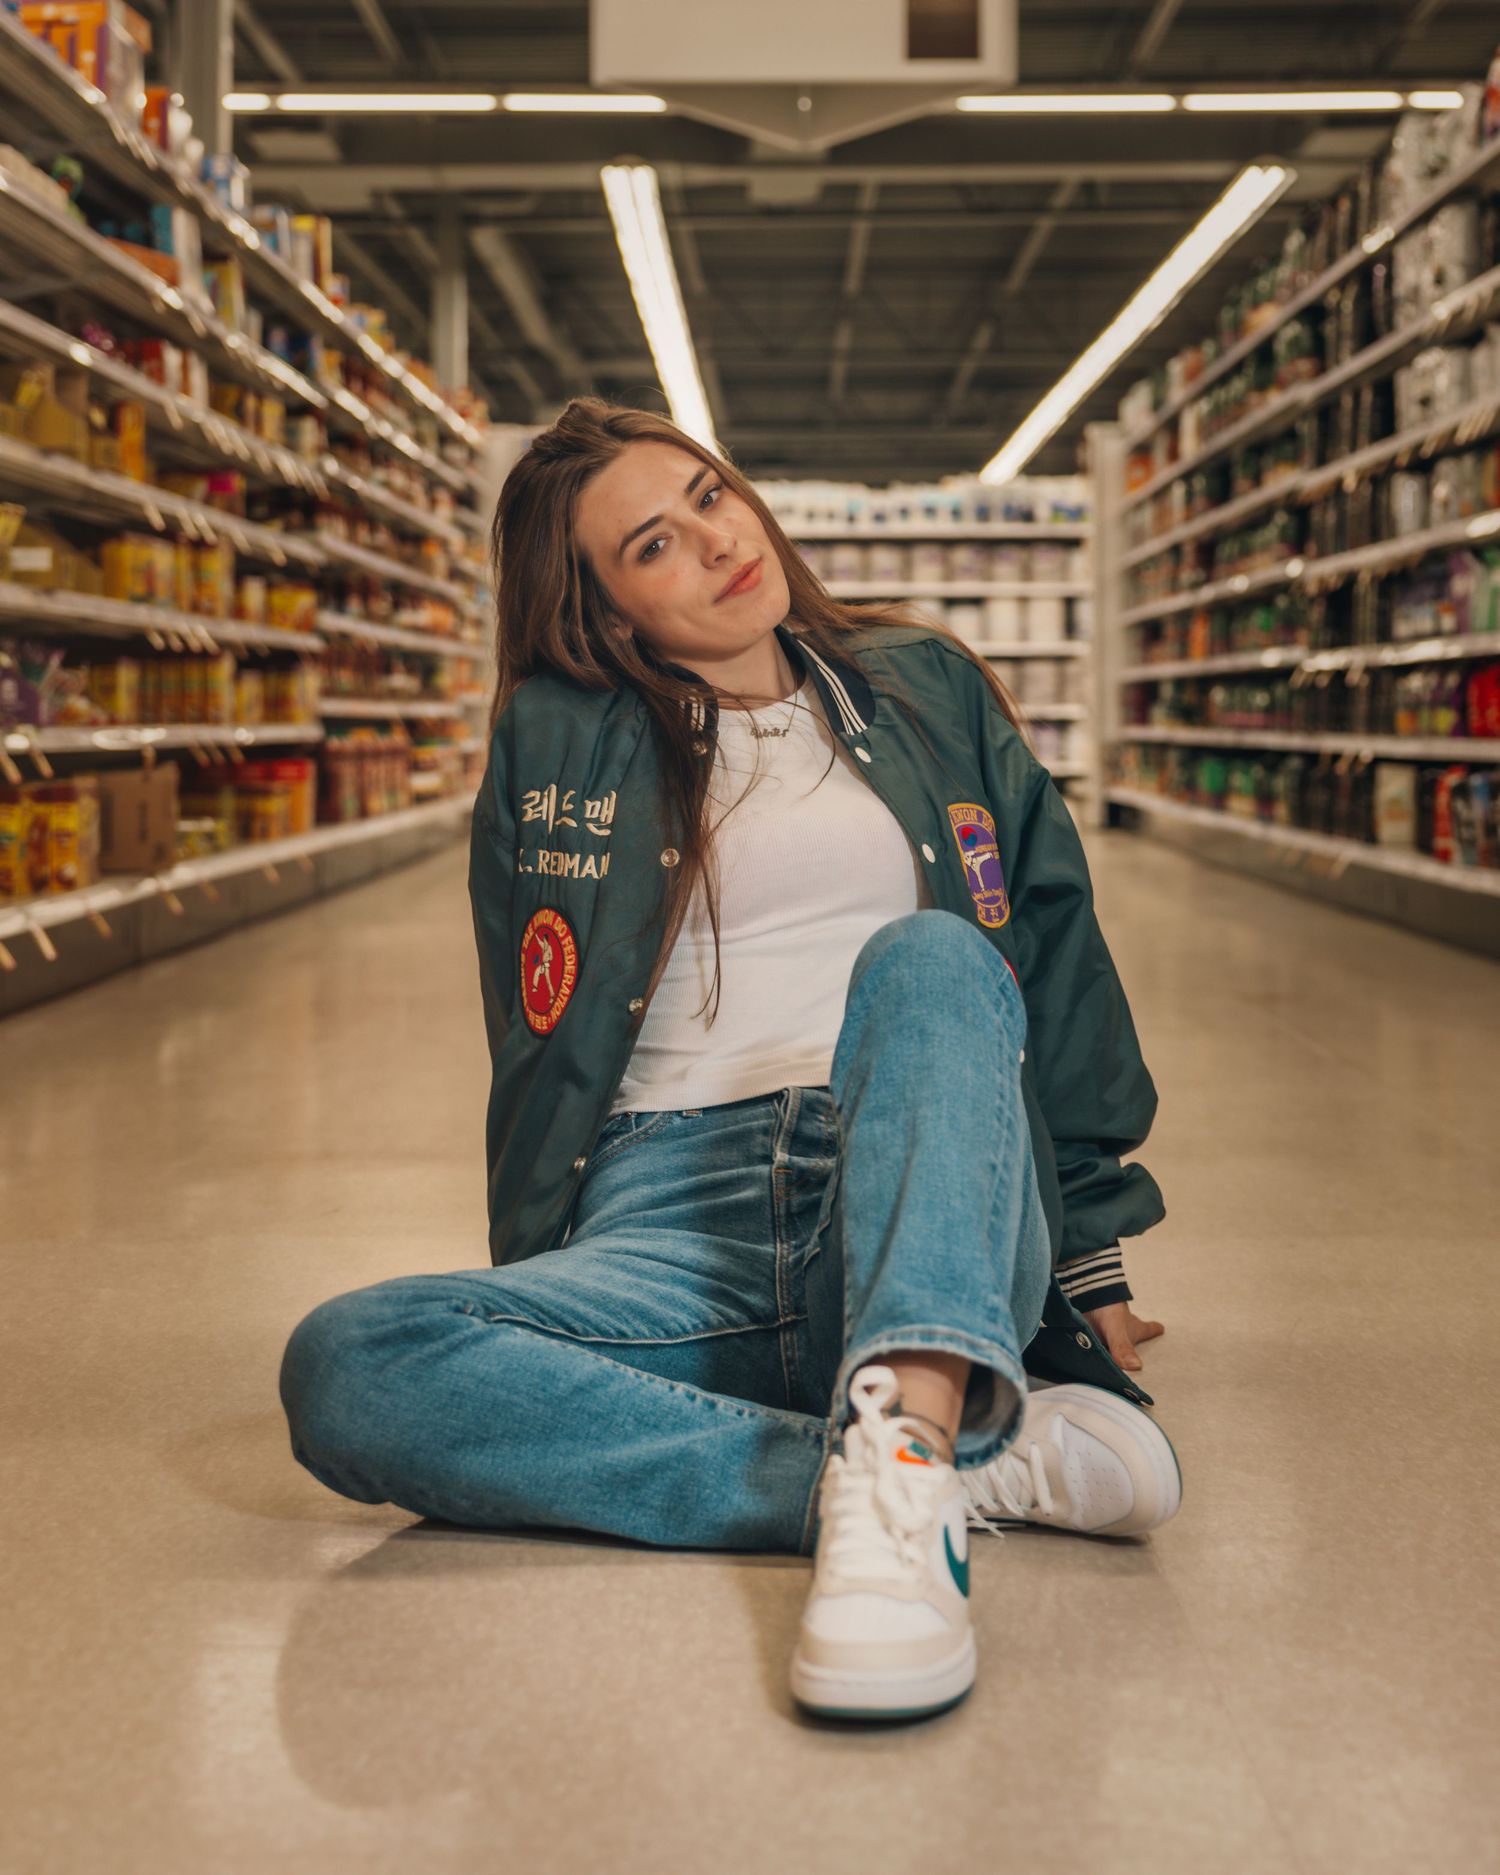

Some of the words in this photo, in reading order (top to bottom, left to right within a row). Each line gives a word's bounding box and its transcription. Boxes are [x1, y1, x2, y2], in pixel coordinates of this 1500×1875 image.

[538, 849, 611, 879] REDMAN
[553, 916, 568, 938] DO
[550, 935, 577, 1023] FEDERATION
